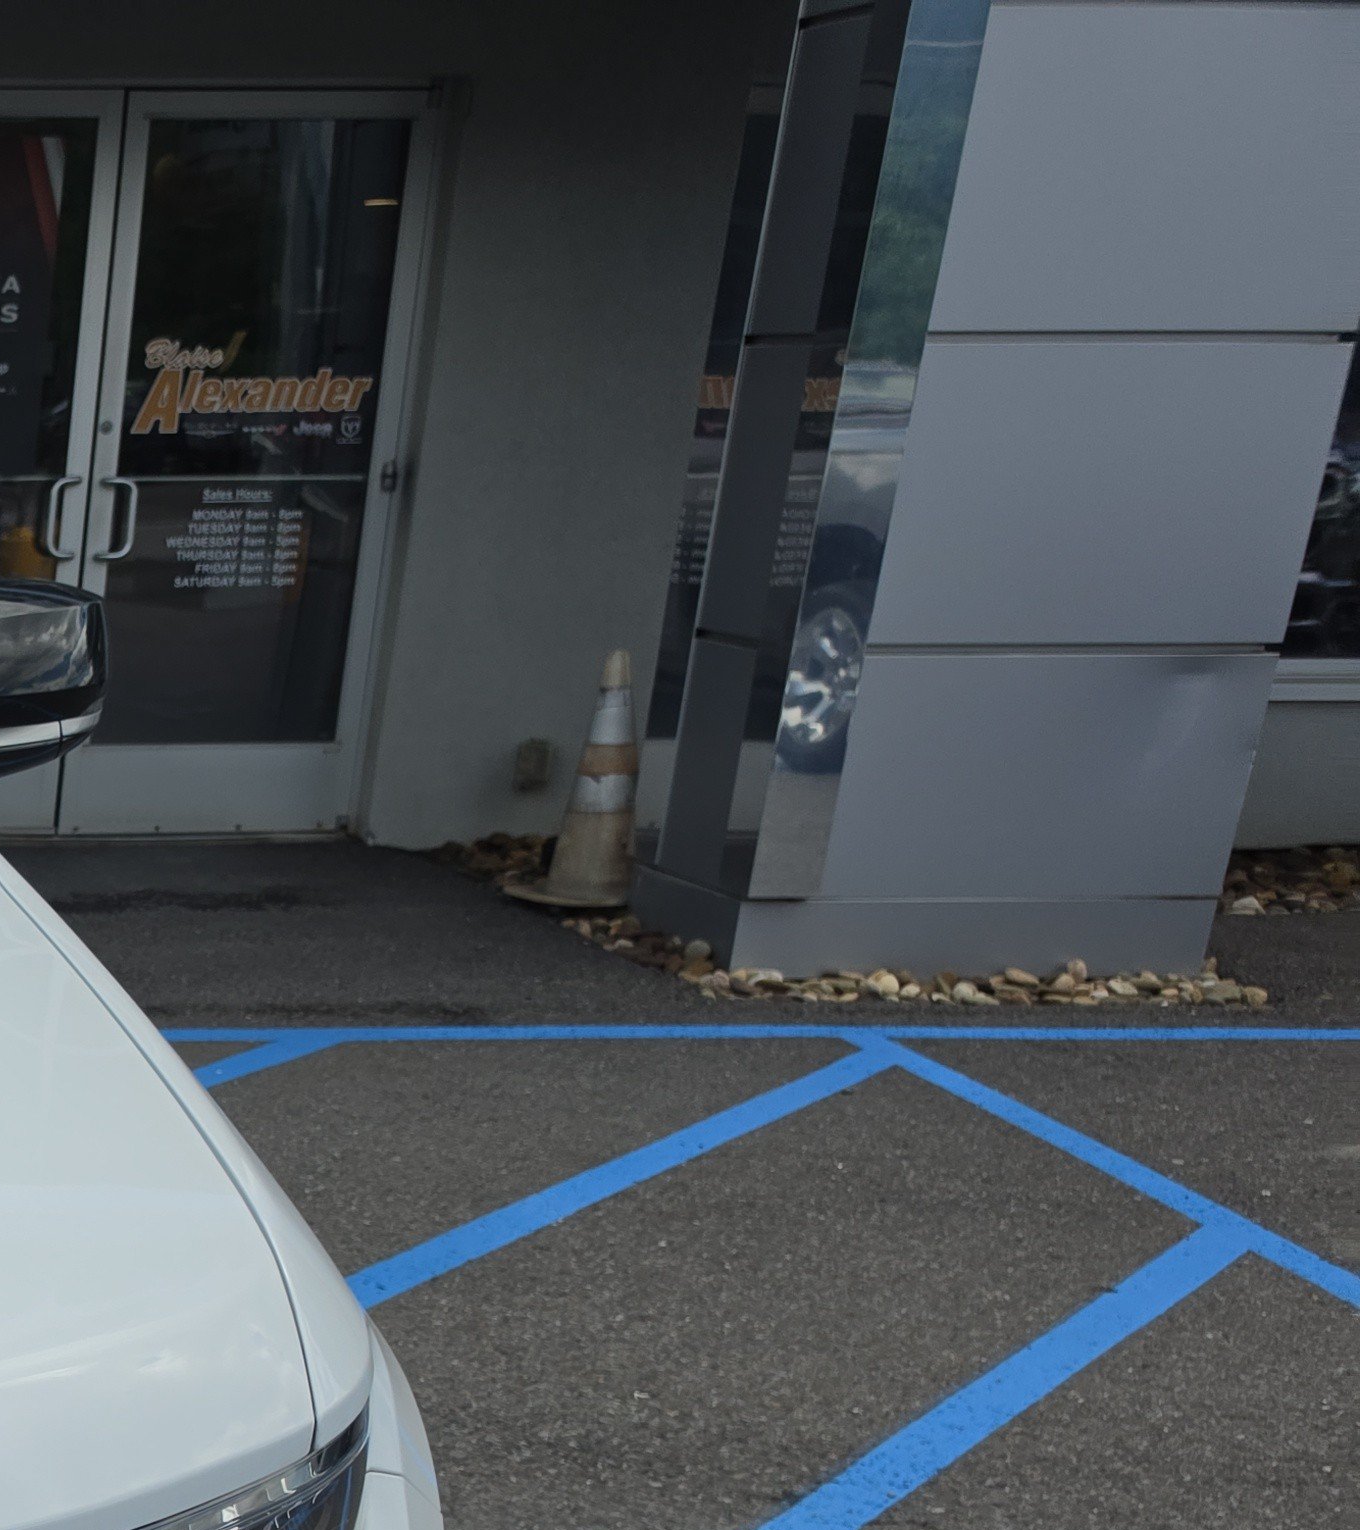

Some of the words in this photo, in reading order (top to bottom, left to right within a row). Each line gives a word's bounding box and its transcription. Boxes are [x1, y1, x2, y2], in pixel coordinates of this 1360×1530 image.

[130, 367, 373, 434] Alexander
[202, 487, 233, 501] Sales
[192, 508, 243, 520] MONDAY
[188, 522, 242, 534] TUESDAY
[166, 536, 240, 548] WEDNESDAY
[176, 549, 240, 561] THURSDAY
[194, 563, 238, 574] FRIDAY
[174, 576, 237, 588] SATURDAY
